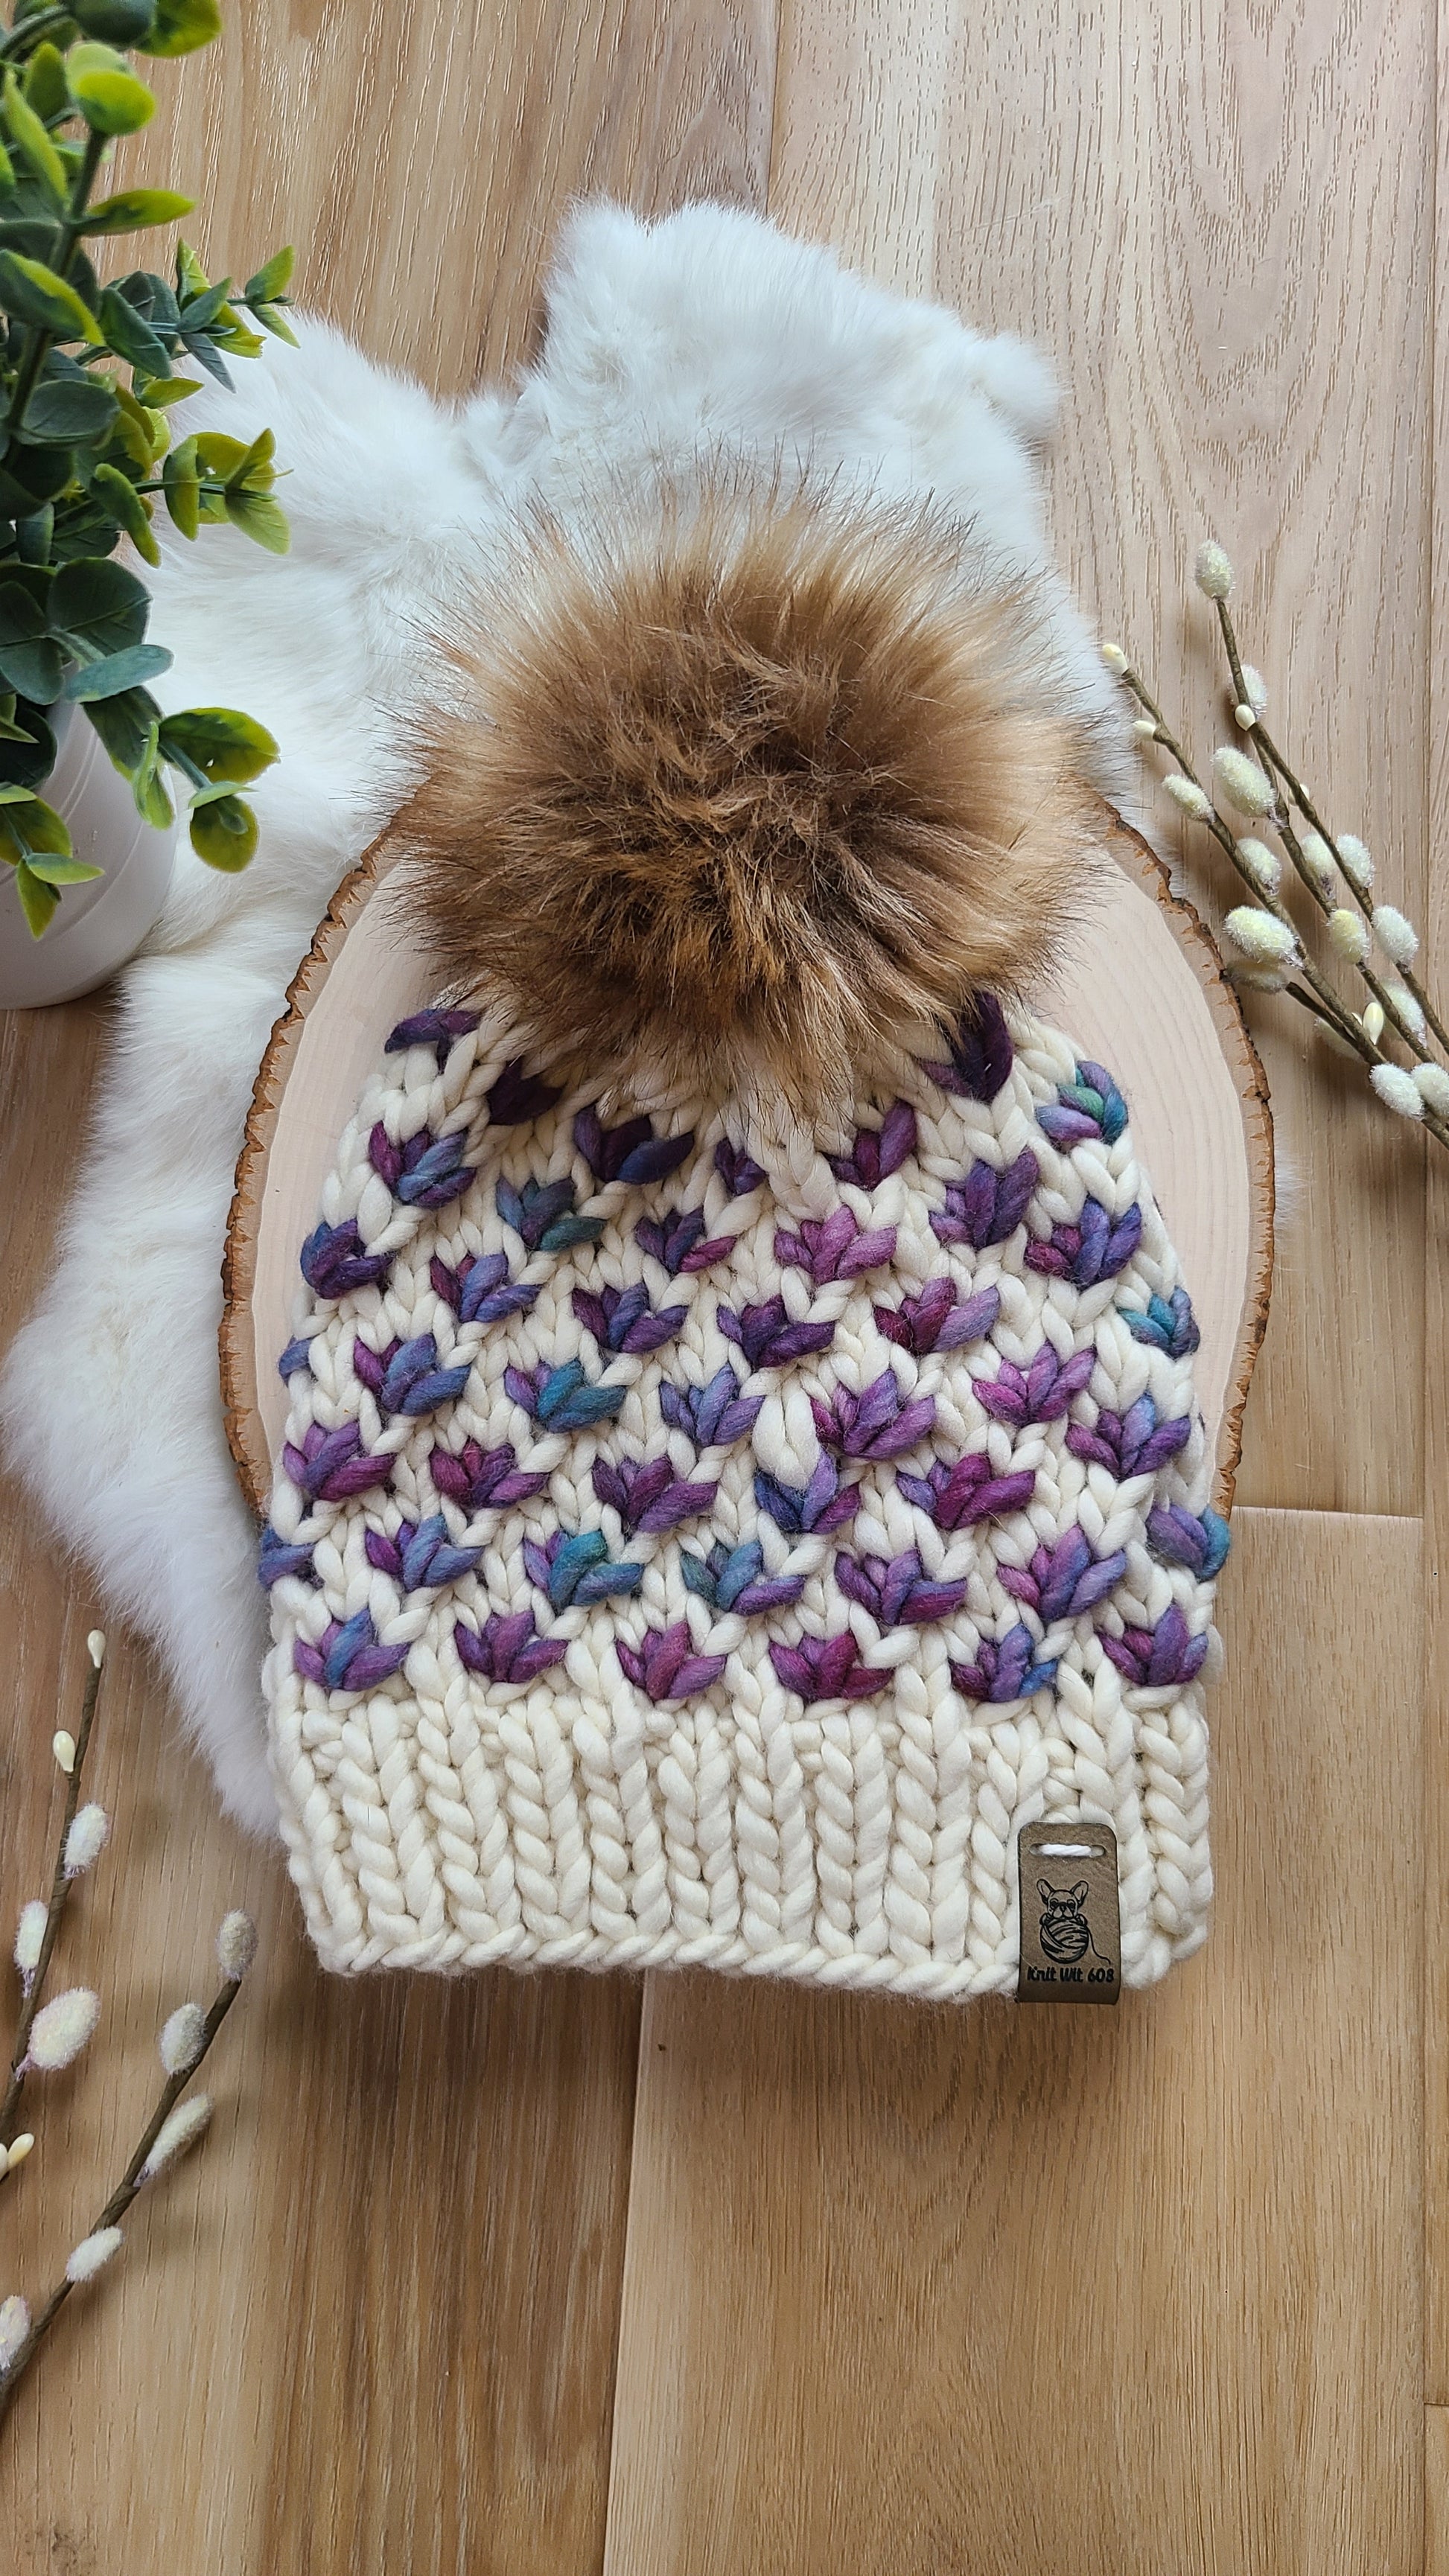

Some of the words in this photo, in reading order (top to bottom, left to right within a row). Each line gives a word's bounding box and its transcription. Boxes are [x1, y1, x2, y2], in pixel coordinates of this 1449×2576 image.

[1027, 1966, 1057, 1982] Knit
[1060, 1967, 1083, 1983] Wit
[1087, 1968, 1115, 1983] 608
